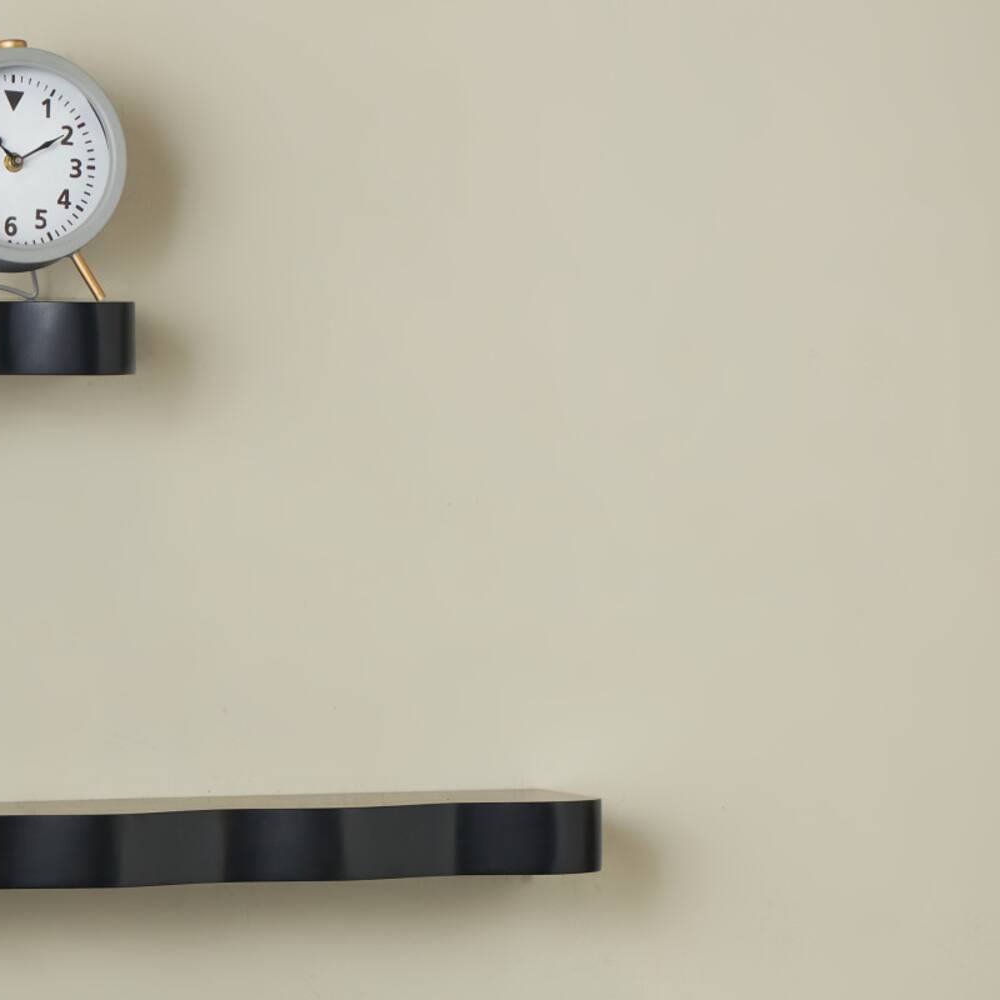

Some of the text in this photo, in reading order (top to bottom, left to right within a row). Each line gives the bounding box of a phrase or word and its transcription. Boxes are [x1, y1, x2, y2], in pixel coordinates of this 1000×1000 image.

[41, 98, 52, 119] 1
[60, 125, 74, 146] 2
[69, 158, 82, 179] 3
[56, 189, 72, 210] 4
[4, 216, 18, 237] 6
[34, 208, 48, 230] 5
